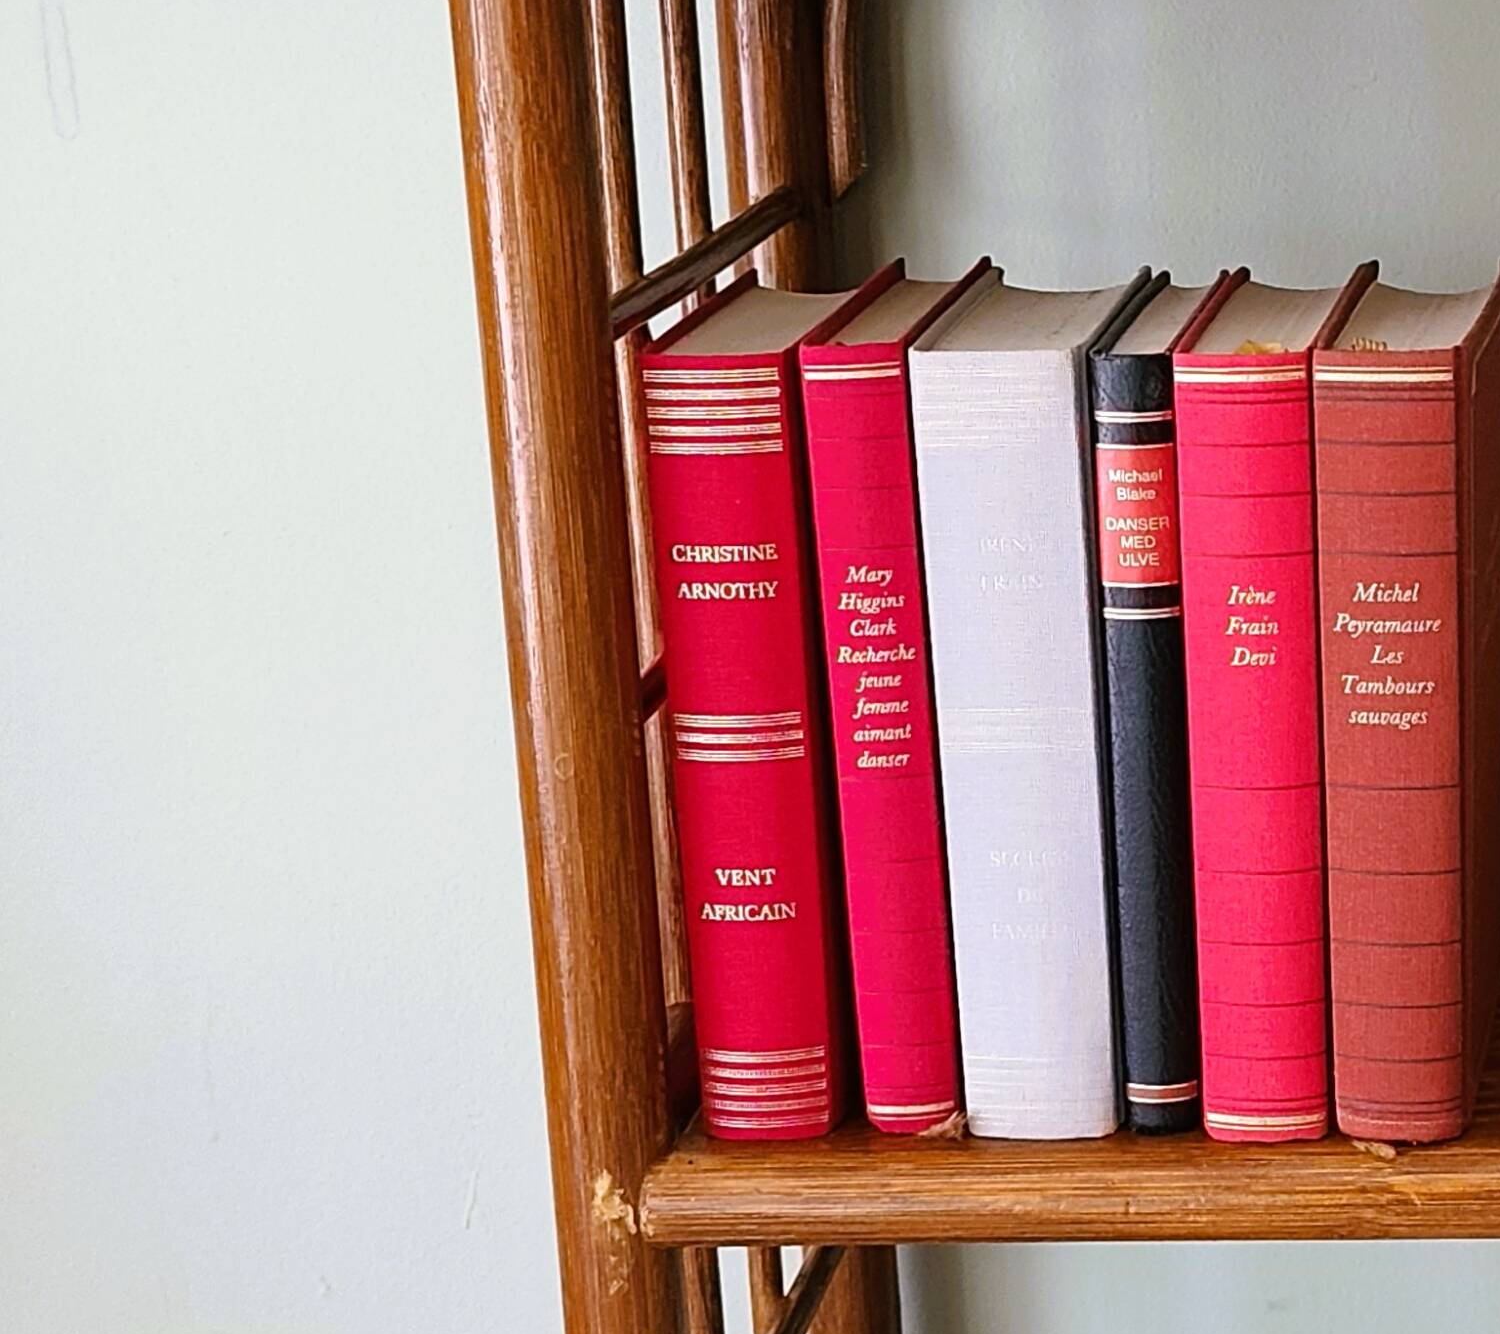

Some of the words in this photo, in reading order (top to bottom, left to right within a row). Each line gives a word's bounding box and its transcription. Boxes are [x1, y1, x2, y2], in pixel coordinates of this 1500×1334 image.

[1108, 468, 1162, 483] Michael
[1116, 487, 1156, 502] Blake
[1105, 515, 1170, 532] DANSER
[1121, 535, 1155, 549] MED
[672, 544, 778, 563] CHRISTINE
[1118, 552, 1159, 567] ULVE
[845, 566, 892, 586] Mary
[678, 582, 777, 599] ARNOTHY
[1228, 586, 1275, 604] Irène
[1353, 583, 1419, 602] Michel
[838, 592, 904, 614] Higgins
[850, 618, 896, 636] Clark
[1225, 616, 1278, 635] Frain
[1333, 613, 1440, 638] Peyramaure
[837, 644, 915, 663] Recherche
[1231, 647, 1276, 665] Devi
[1371, 645, 1403, 663] Les
[855, 672, 901, 692] jeune
[1341, 675, 1434, 694] Tambours
[852, 697, 908, 719] femme
[1349, 711, 1427, 729] sauvages
[853, 724, 911, 741] aimant
[857, 751, 909, 767] danser
[715, 869, 775, 886] VENT
[702, 903, 795, 921] AFRICAIN
